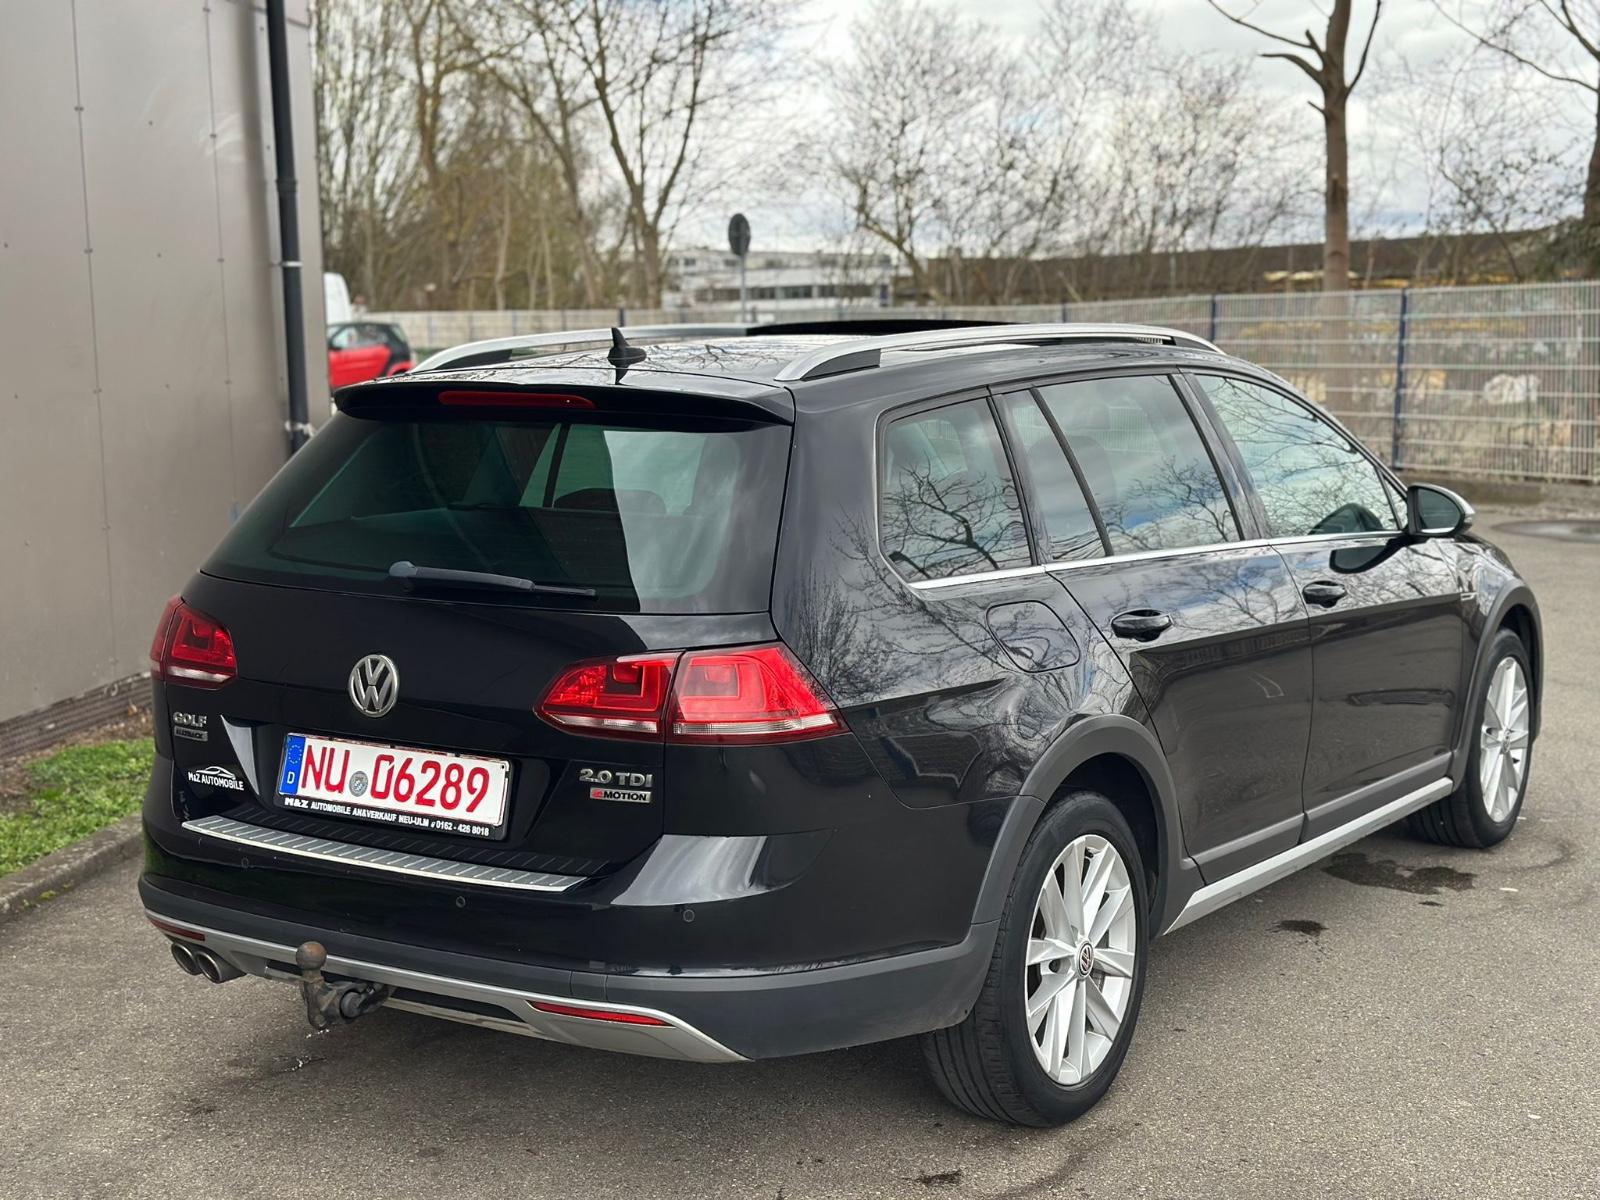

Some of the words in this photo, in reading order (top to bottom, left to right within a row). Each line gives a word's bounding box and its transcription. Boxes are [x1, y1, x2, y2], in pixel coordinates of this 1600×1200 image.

[173, 711, 207, 727] GOLF
[201, 774, 245, 791] AUTOMOBILE
[287, 771, 296, 784] D
[301, 744, 350, 793] NU
[370, 753, 490, 813] 06289
[579, 768, 612, 784] 2.0
[615, 771, 653, 788] TDI
[310, 801, 352, 815] AUTOMOBILE
[352, 807, 397, 822] AN&VERKAUF
[398, 814, 430, 828] NEU-ULM
